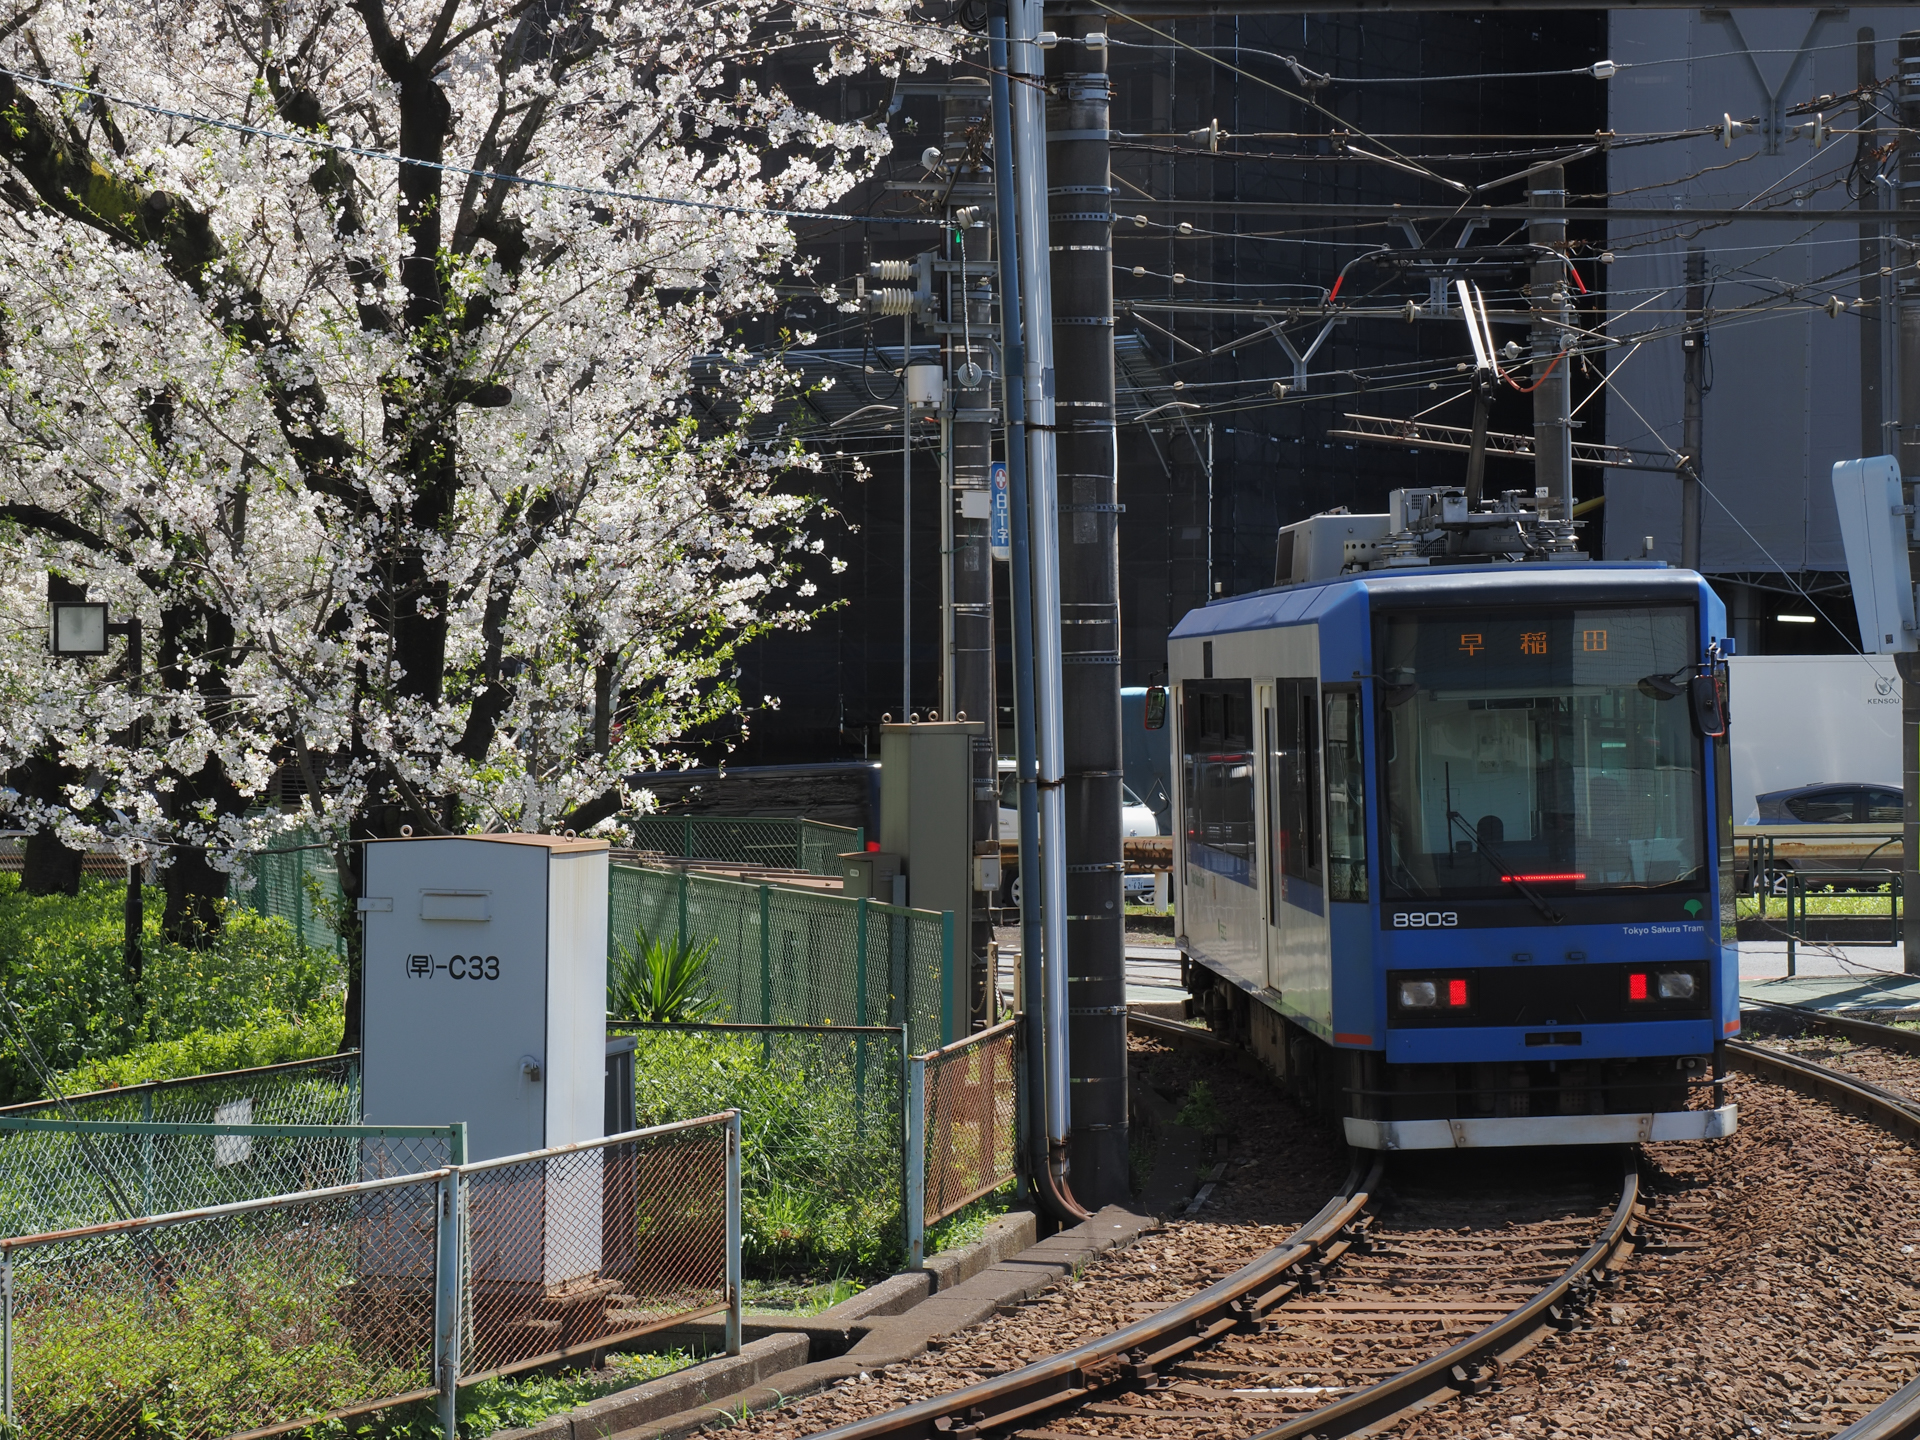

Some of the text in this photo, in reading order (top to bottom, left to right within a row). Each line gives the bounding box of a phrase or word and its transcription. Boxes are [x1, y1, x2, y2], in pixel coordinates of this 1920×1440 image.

[997, 493, 1008, 544] 白十字
[1459, 630, 1608, 656] 早稲田
[1393, 912, 1459, 928] 8903
[1623, 924, 1704, 936] Tokyo Sakura Tram
